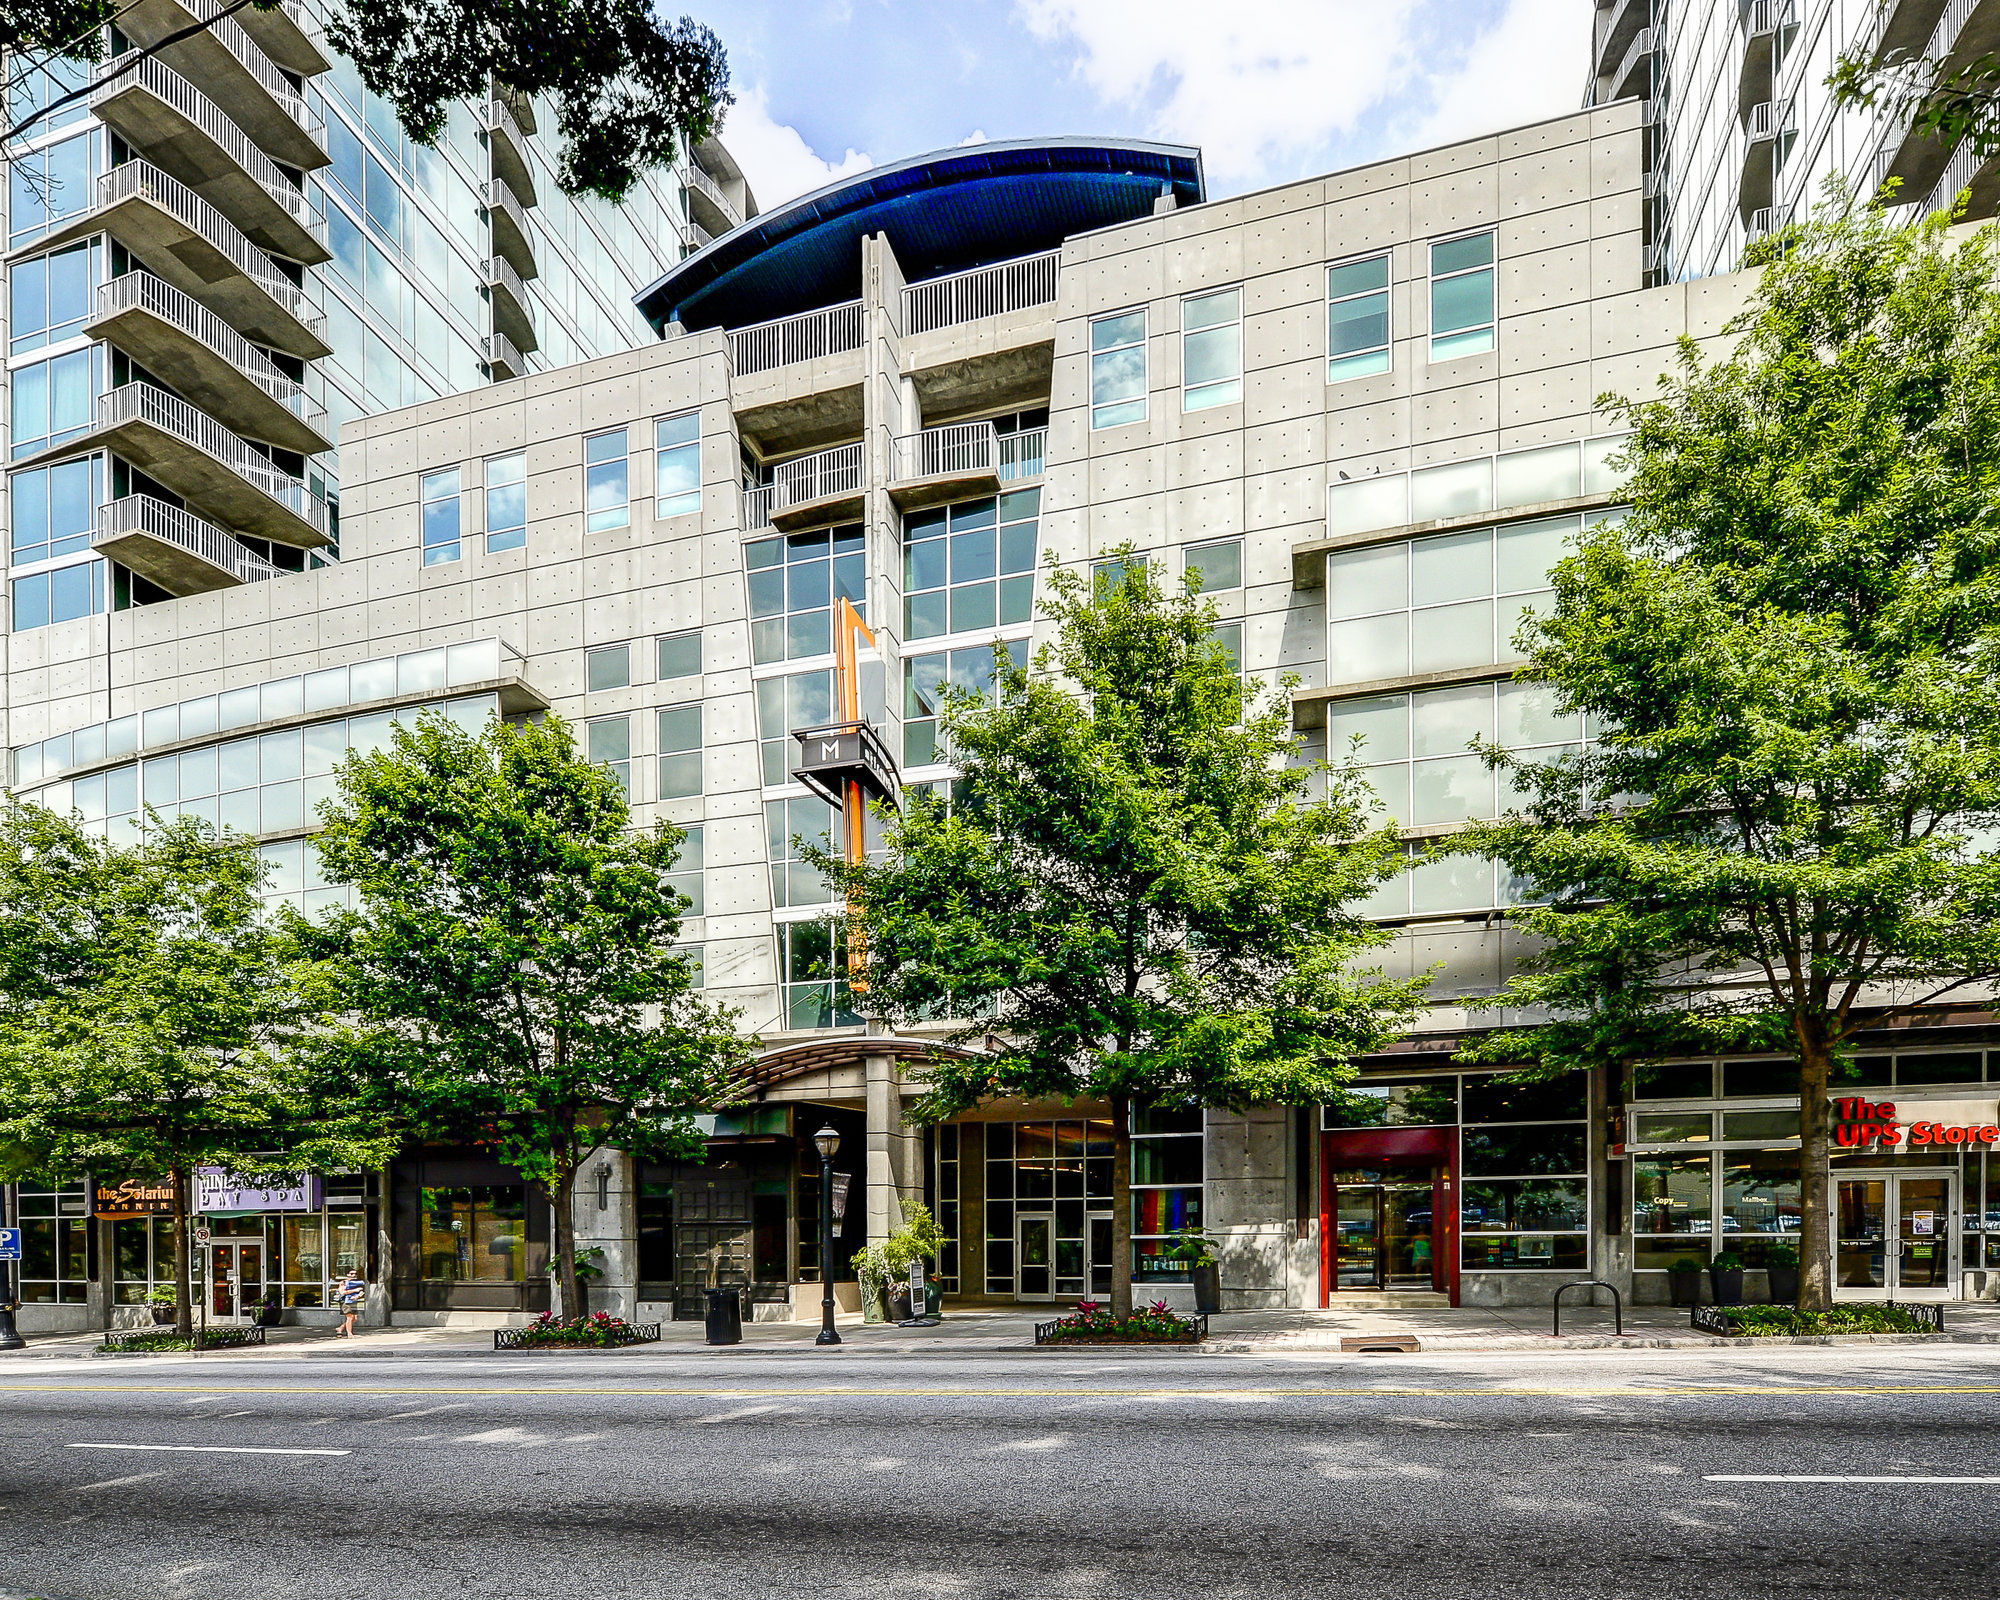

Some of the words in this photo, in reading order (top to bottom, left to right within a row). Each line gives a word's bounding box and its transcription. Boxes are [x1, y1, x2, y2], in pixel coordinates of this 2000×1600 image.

[821, 739, 839, 761] M
[1835, 1097, 1896, 1120] The
[1837, 1123, 1902, 1147] UPS
[1912, 1121, 2000, 1145] Store
[97, 1187, 118, 1200] the
[200, 1191, 240, 1205] DAY
[260, 1189, 303, 1203] SPA
[1653, 1196, 1674, 1206] Copy
[97, 1202, 169, 1211] TANNIN
